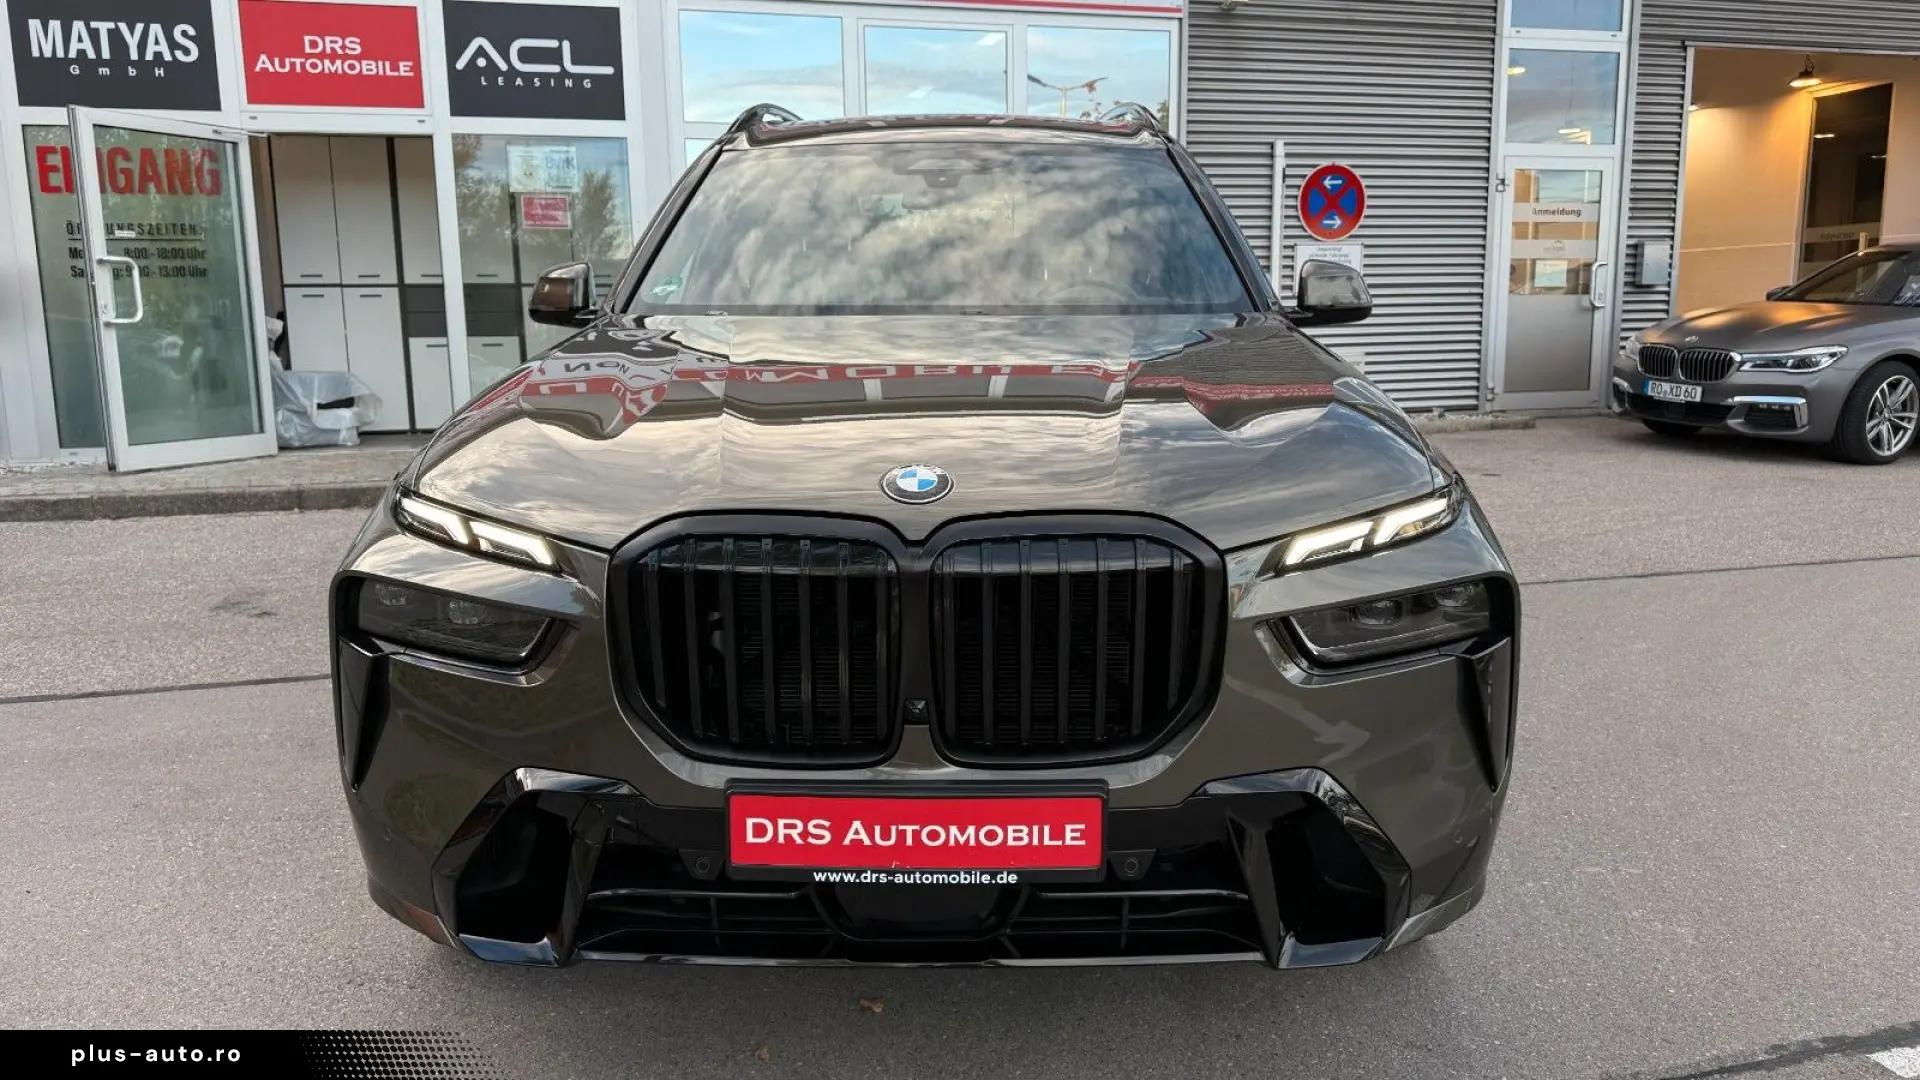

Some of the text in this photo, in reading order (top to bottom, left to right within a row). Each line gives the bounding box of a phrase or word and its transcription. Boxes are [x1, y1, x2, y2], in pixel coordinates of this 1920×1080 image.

[28, 18, 199, 63] MATYAS
[303, 35, 361, 56] DRS
[456, 36, 614, 75] ACL
[255, 54, 414, 77] AUTOMOBILE
[480, 76, 592, 89] LEASING
[35, 145, 222, 196] EIGANG
[1532, 207, 1582, 218] Anmeldung
[186, 247, 206, 259] Uhr
[188, 265, 207, 277] Uhr
[1650, 382, 1698, 399] RO XD 60
[745, 817, 1087, 847] DRS AUTOMOBILE
[813, 869, 1018, 885] www.drs-automobile.de
